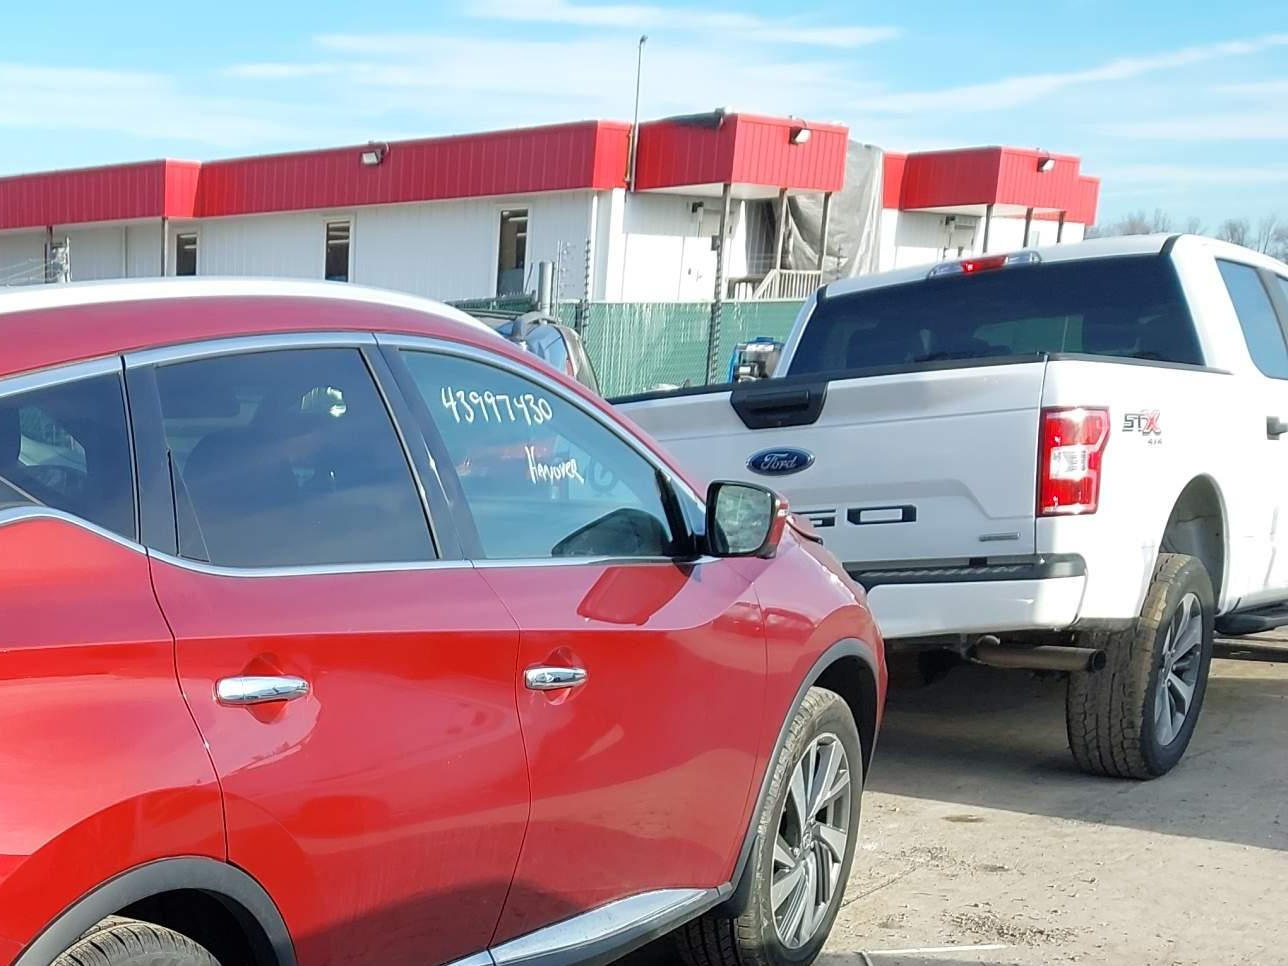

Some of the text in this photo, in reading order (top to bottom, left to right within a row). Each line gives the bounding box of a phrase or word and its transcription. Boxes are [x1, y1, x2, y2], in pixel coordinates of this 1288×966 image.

[441, 386, 553, 426] 43997430
[1121, 410, 1162, 436] STX
[760, 452, 798, 470] Ford
